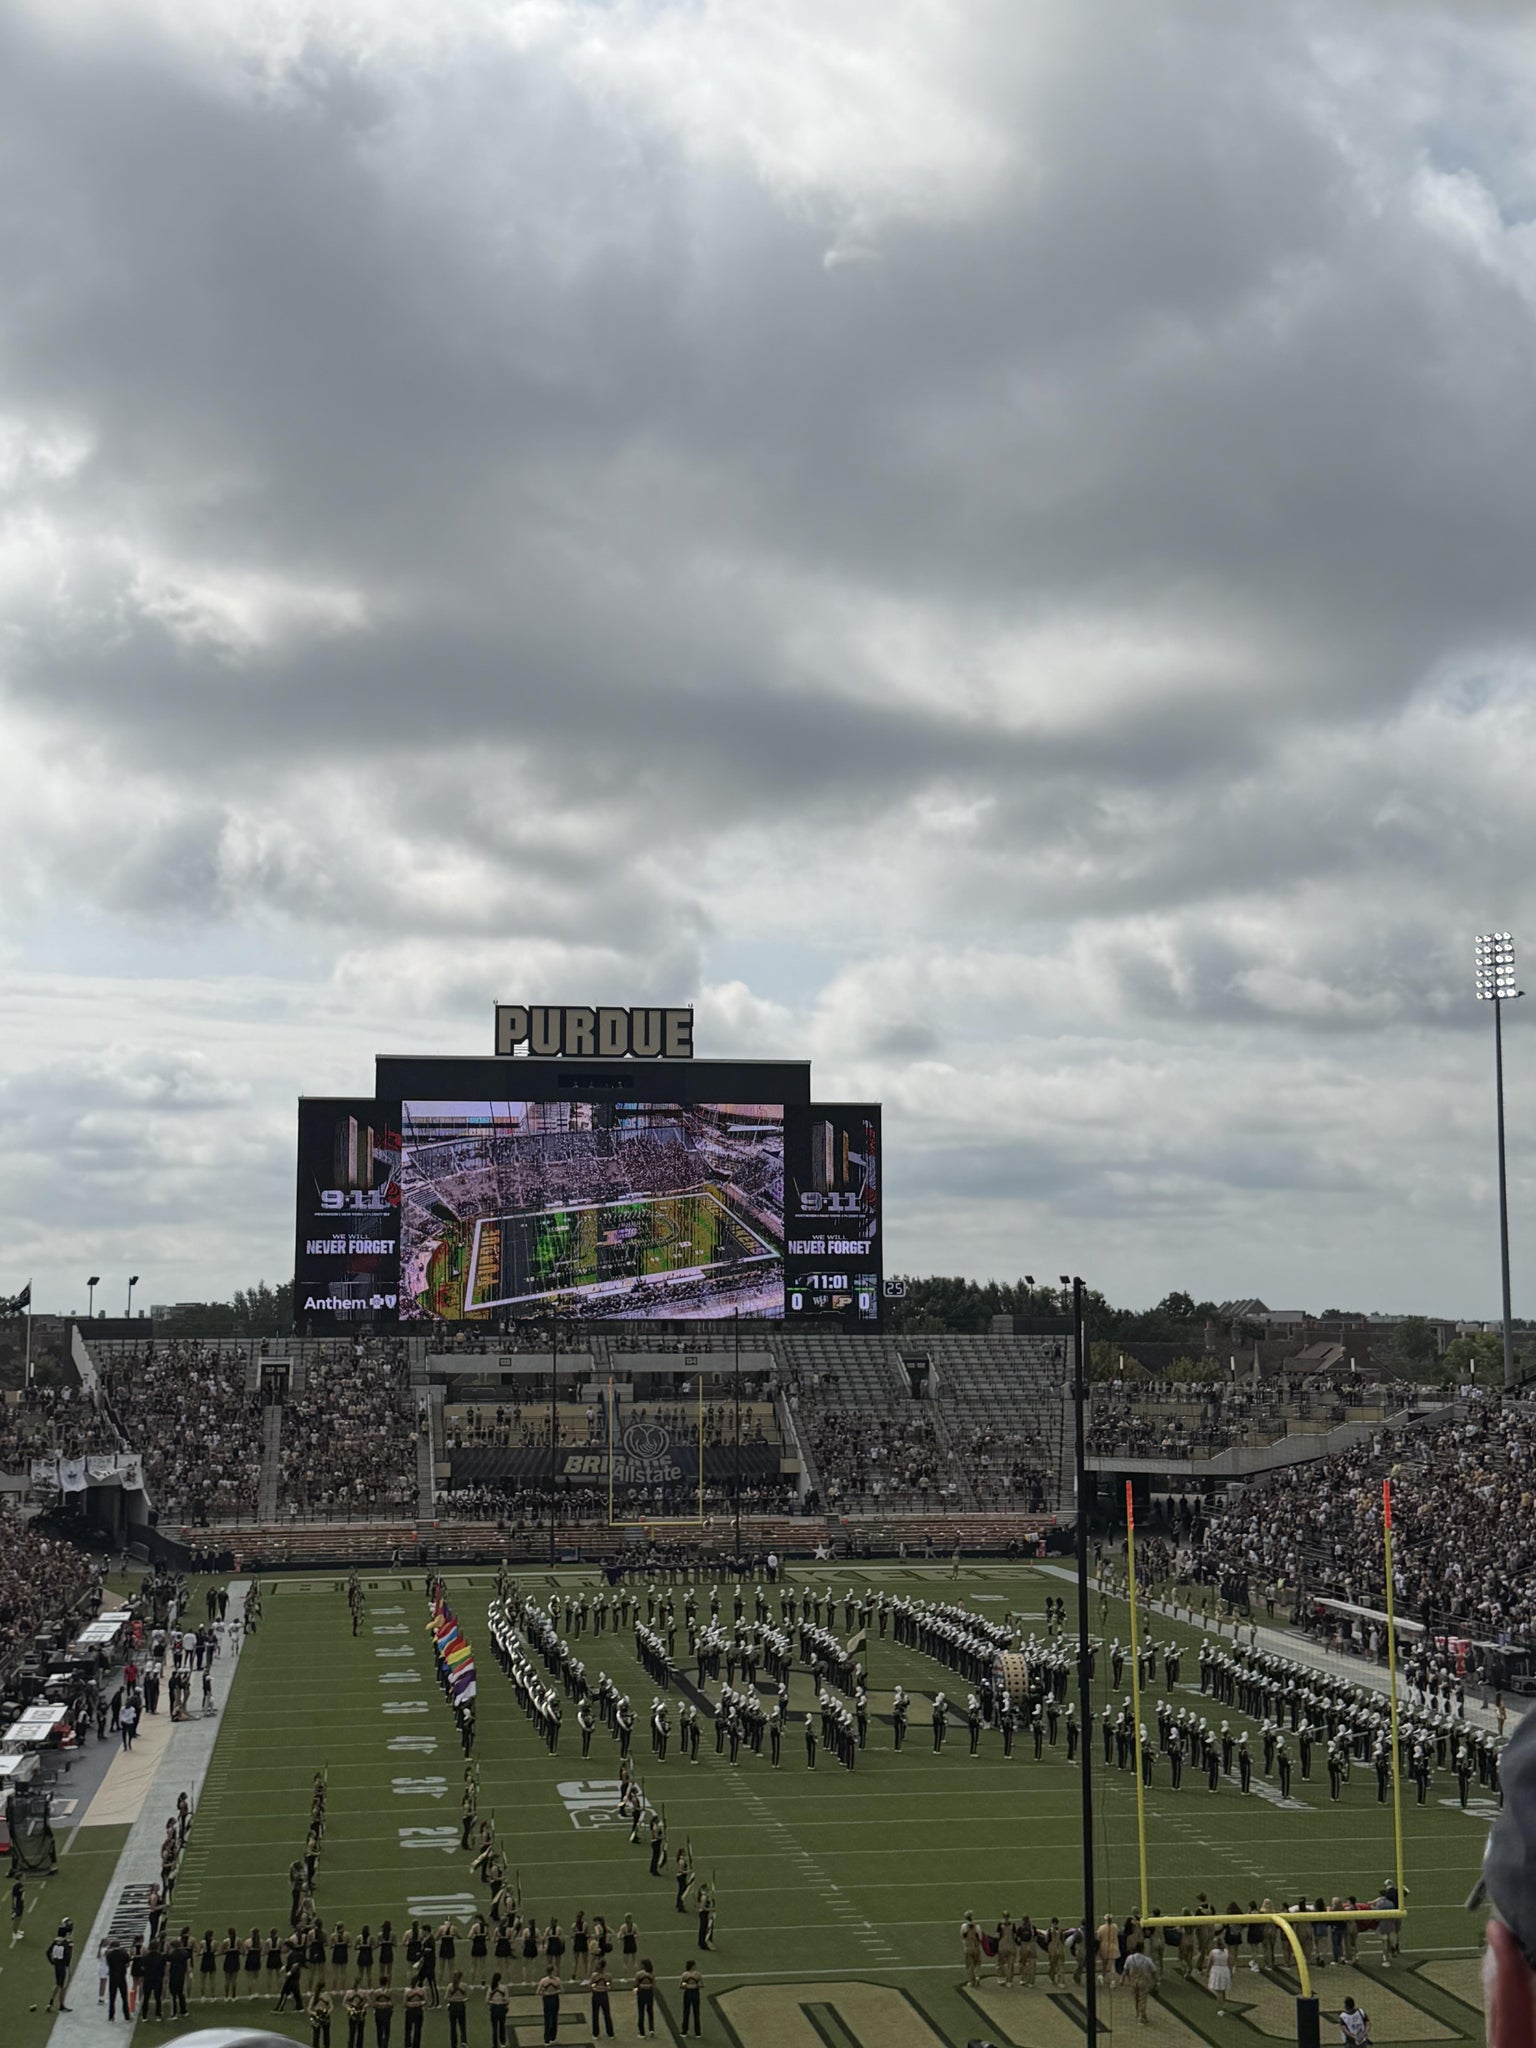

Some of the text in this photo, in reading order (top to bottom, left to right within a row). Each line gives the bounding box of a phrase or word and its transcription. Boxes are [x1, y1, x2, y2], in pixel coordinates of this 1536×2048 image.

[495, 1006, 693, 1058] PURDUE
[306, 1240, 395, 1254] NEVER FORGET
[788, 1241, 871, 1254] NEVER FORGET
[812, 1274, 848, 1289] 11:01
[886, 1282, 903, 1295] 25
[304, 1296, 367, 1310] Anthem
[791, 1293, 803, 1310] 0
[859, 1293, 870, 1310] 0
[612, 1465, 682, 1483] Allstate
[386, 1735, 438, 1750] 40
[391, 1776, 449, 1794] 30
[398, 1826, 461, 1848] 20
[406, 1892, 478, 1917] 10
